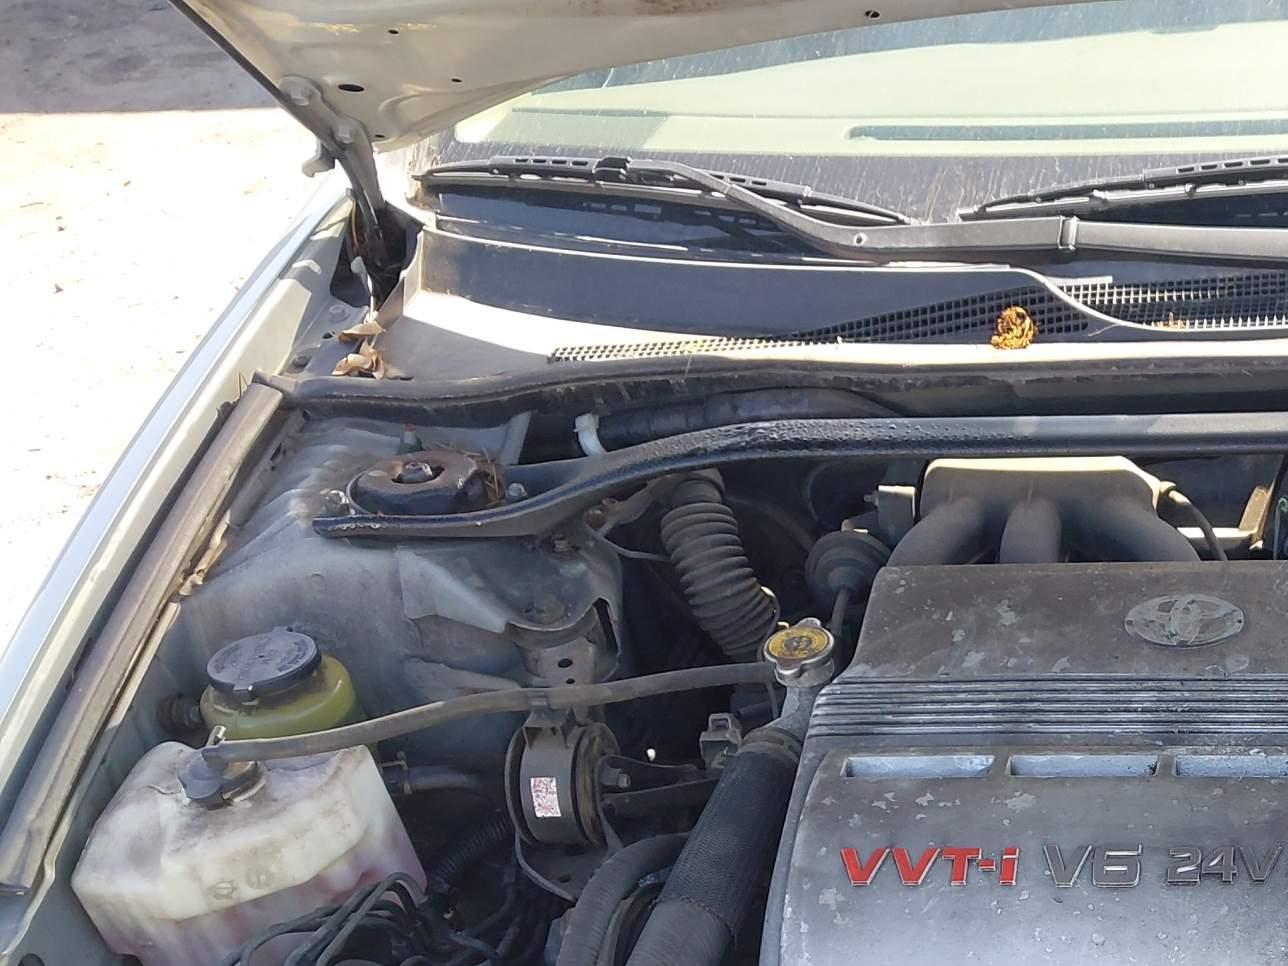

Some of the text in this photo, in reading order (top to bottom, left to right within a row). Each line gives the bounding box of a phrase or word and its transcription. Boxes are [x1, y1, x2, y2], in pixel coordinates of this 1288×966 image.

[841, 843, 1284, 888] VVT-i V6 24V
